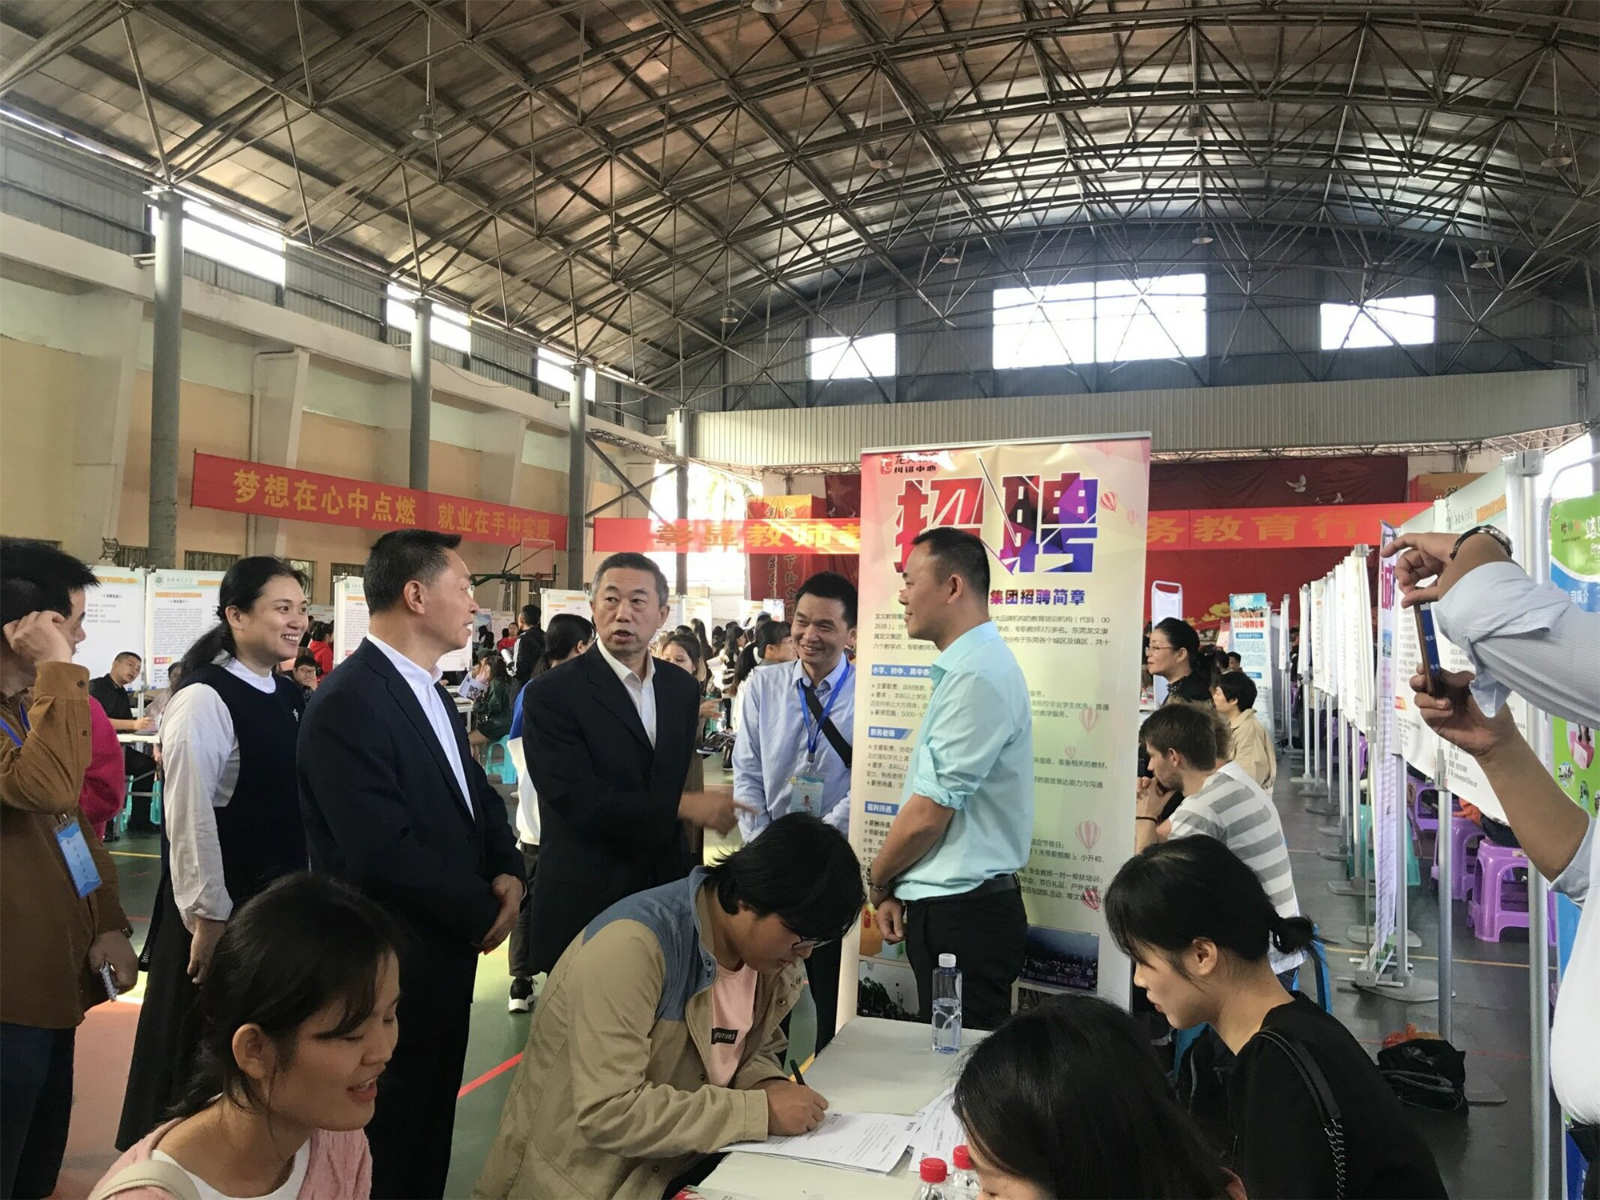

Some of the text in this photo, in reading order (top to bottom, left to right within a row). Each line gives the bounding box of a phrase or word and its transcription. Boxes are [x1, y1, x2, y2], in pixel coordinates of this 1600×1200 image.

[233, 468, 417, 526] 梦想在心中点燃
[894, 472, 1099, 576] 招聘
[990, 588, 1086, 606] 集团招聘简章
